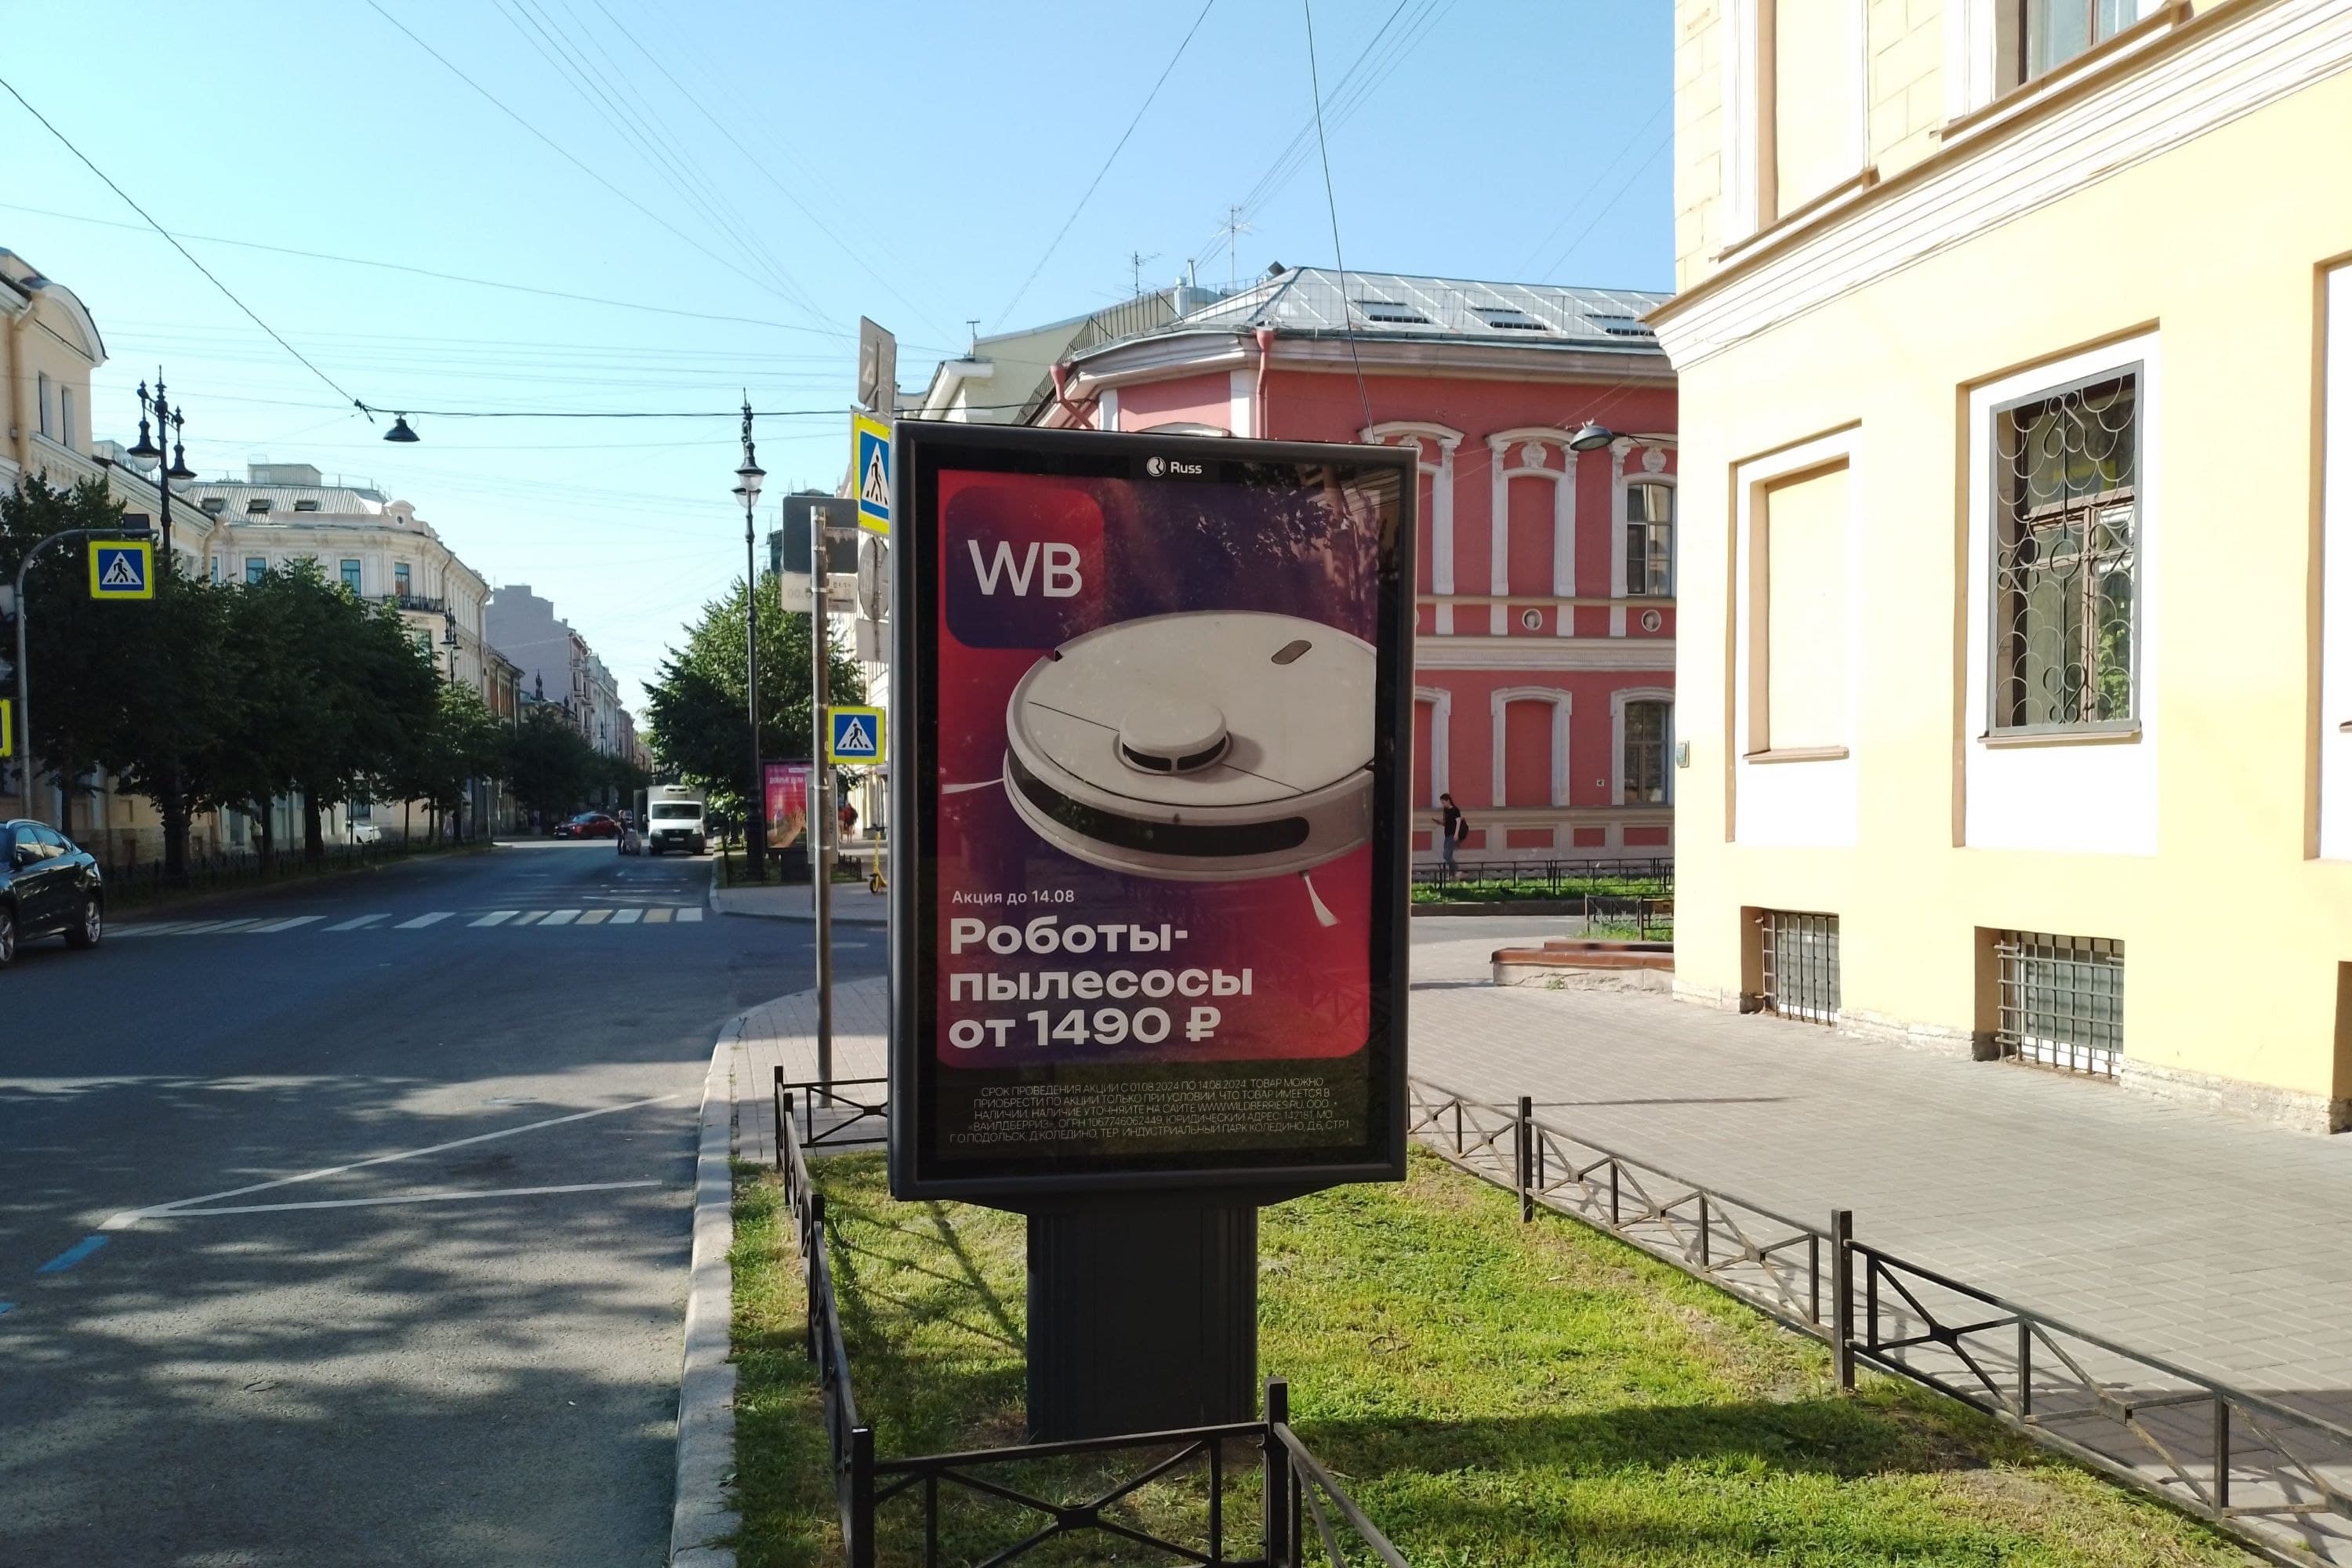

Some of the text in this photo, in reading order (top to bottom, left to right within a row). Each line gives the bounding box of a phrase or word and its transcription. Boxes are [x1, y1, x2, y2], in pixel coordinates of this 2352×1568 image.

[1171, 461, 1203, 474] Russ
[967, 539, 1083, 597] WB
[952, 890, 1075, 906] Акция до 14.08
[950, 915, 1189, 955] Роботы-
[949, 968, 1253, 1002] пылесосы
[949, 1018, 1016, 1049] от
[1027, 1007, 1171, 1047] 1490
[981, 1087, 1010, 1097] СРОК
[1012, 1084, 1081, 1096] ПРОВЕДЕНИЯ
[1083, 1083, 1118, 1094] АКЦИИ
[1120, 1083, 1128, 1092] С
[1181, 1080, 1196, 1091] ПО
[1250, 1079, 1283, 1088] ТОВАР
[1283, 1077, 1323, 1087] МОЖНО
[973, 1097, 1044, 1109] ПРИОБРЕСТИ
[1046, 1097, 1062, 1106] ПО
[1063, 1095, 1099, 1105] АКЦИИ
[1102, 1094, 1142, 1105] ТОЛЬКО
[1144, 1093, 1165, 1103] ПРИ
[1219, 1091, 1240, 1100] ЧТО
[1242, 1090, 1273, 1100] ТОВАР
[1276, 1088, 1322, 1098] ИМЕЕТСЯ
[1323, 1087, 1330, 1098] В
[1031, 1107, 1082, 1118] НАЛИЧИЕ
[1083, 1104, 1145, 1116] УТОЧНЯЙТЕ
[1146, 1105, 1160, 1113] НА
[1162, 1102, 1196, 1113] САЙТЕ
[1306, 1099, 1329, 1109] ООО
[1058, 1118, 1086, 1128] ОГРН
[1166, 1112, 1245, 1123] ЮРИДИЧЕСКИЙ
[1122, 1124, 1220, 1138] ИНДУСТРИАЛЬНЫЙ
[1222, 1123, 1247, 1134] ПАРК
